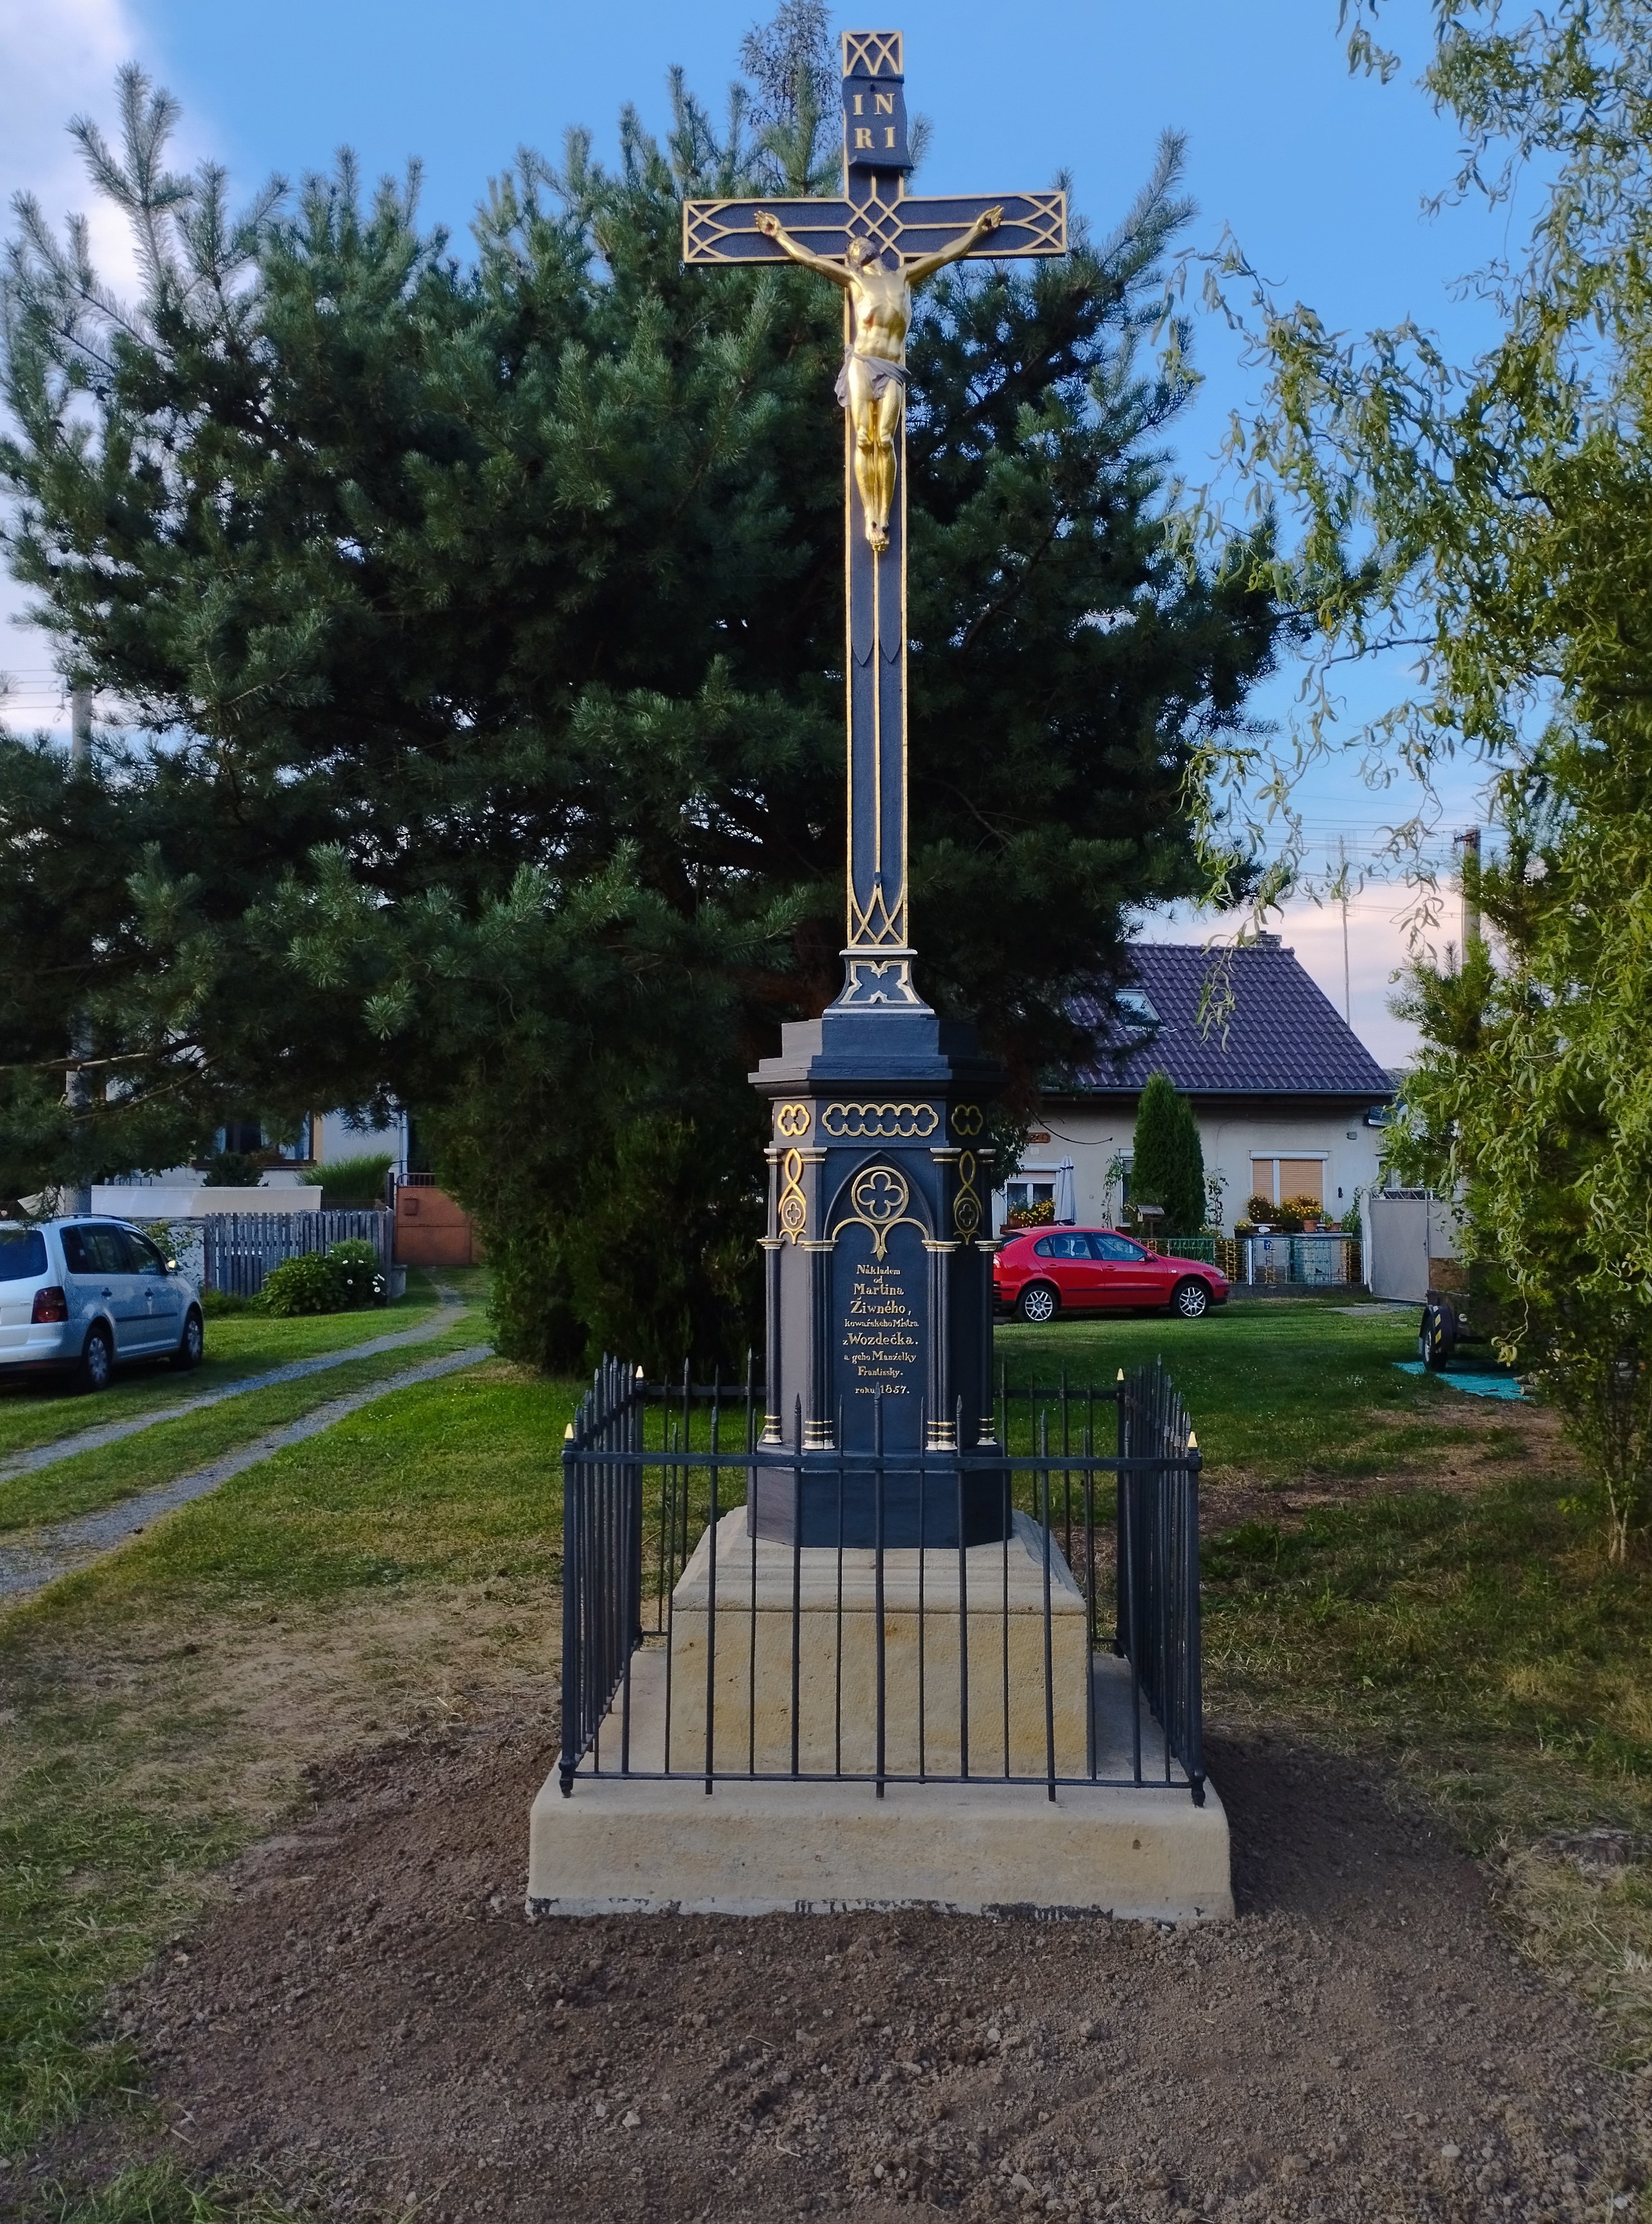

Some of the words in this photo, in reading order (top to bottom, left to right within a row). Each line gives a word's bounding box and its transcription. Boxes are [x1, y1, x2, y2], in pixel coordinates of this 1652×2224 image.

[854, 1283, 904, 1295] Martina
[852, 1352, 870, 1364] geho
[880, 1385, 910, 1394] 1857.
